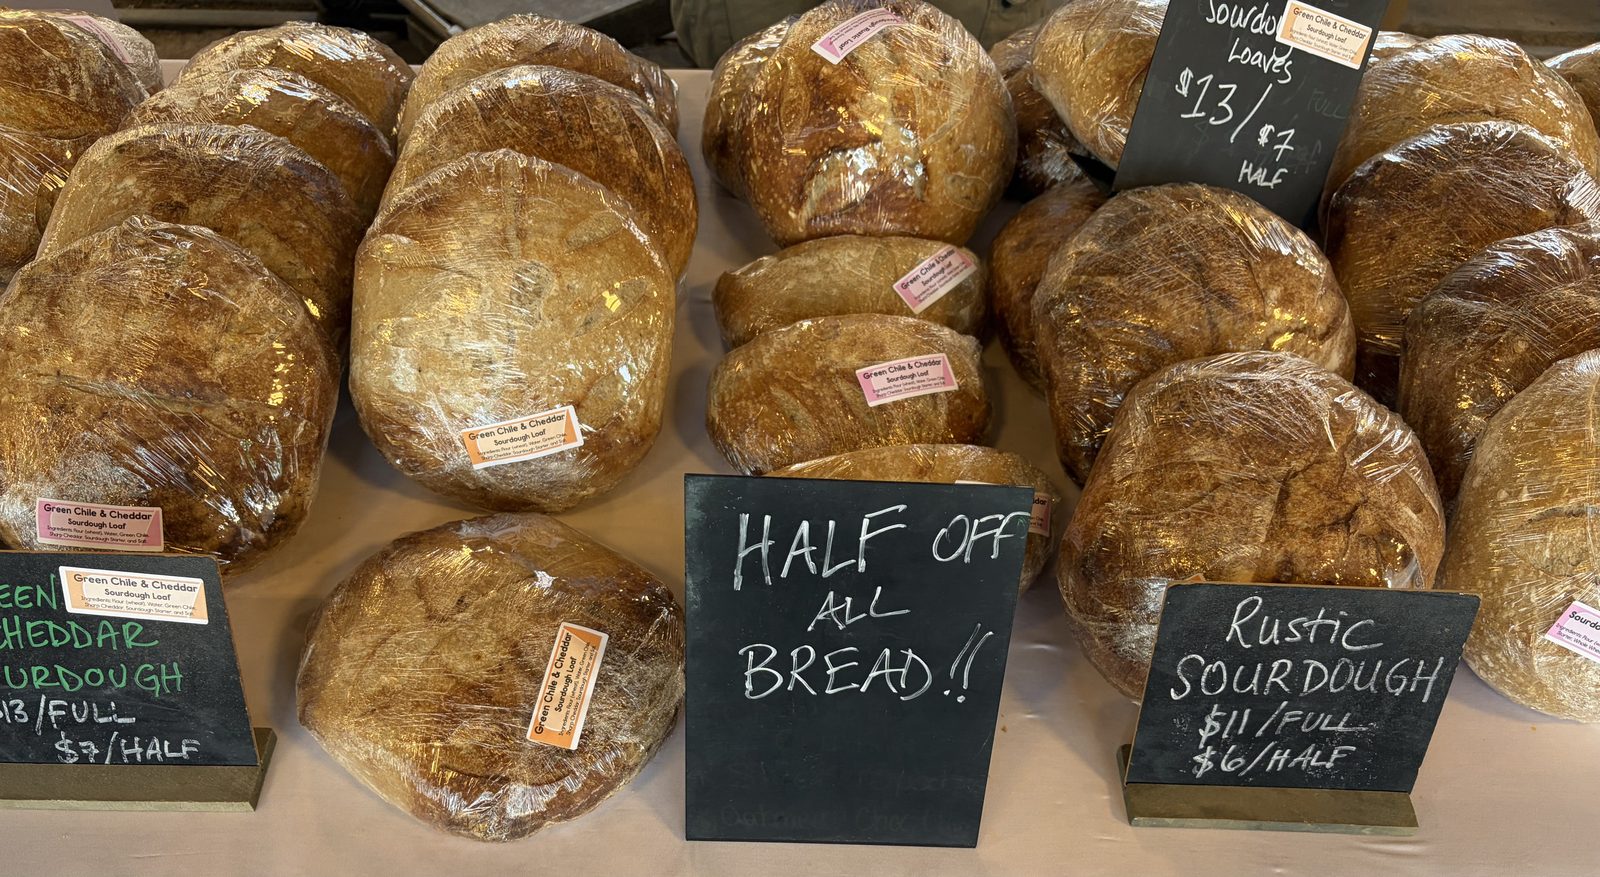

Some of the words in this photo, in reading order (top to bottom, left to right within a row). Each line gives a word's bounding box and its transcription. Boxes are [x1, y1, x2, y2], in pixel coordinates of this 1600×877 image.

[852, 26, 870, 40] Rustic
[1293, 7, 1313, 20] Green
[1315, 16, 1331, 27] Chile
[1339, 24, 1366, 40] Cheddar
[1307, 25, 1334, 40] Sourdough
[1335, 35, 1347, 44] Loaf
[838, 39, 852, 50] Loaf
[1228, 37, 1292, 84] Loaves
[1175, 67, 1272, 143] $13/
[1257, 124, 1295, 161] $7
[1239, 160, 1288, 188] HALF
[900, 275, 921, 290] Green
[920, 264, 936, 276] Chile
[864, 371, 887, 379] Green
[888, 365, 906, 373] Chile
[914, 359, 941, 369] Cheddar
[887, 373, 916, 383] Sourdough
[469, 431, 495, 442] Green
[497, 425, 518, 435] Chile
[520, 422, 527, 430] &
[529, 415, 565, 428] Cheddar
[494, 432, 530, 447] Sourdough
[531, 428, 546, 437] Loaf
[44, 504, 71, 514] Green
[74, 507, 97, 516] Chile
[109, 511, 152, 521] Cheddar
[68, 518, 107, 529] Sourdough
[734, 504, 907, 591] HALF
[932, 512, 1031, 563] OFF
[0, 574, 57, 610] EEN
[74, 574, 108, 584] Green
[111, 577, 137, 587] Chile
[141, 580, 148, 588] &
[152, 581, 197, 592] Cheddar
[105, 589, 150, 599] Sourdough
[807, 586, 911, 631] ALL
[1226, 596, 1383, 650] Rustic
[1568, 611, 1600, 631] Sourdo
[4, 662, 183, 697] URDOUGH
[739, 623, 993, 703] BREAD!!
[1170, 654, 1444, 703] SOURDOUGH
[535, 705, 551, 734] Green
[544, 680, 558, 703] Chile
[554, 632, 573, 669] Cheddar
[555, 675, 573, 713] Sourdough
[569, 656, 578, 673] Loaf
[0, 694, 136, 735] 13/FULL
[55, 731, 200, 764] $7/HALF
[1193, 741, 1356, 778] $6/HALF
